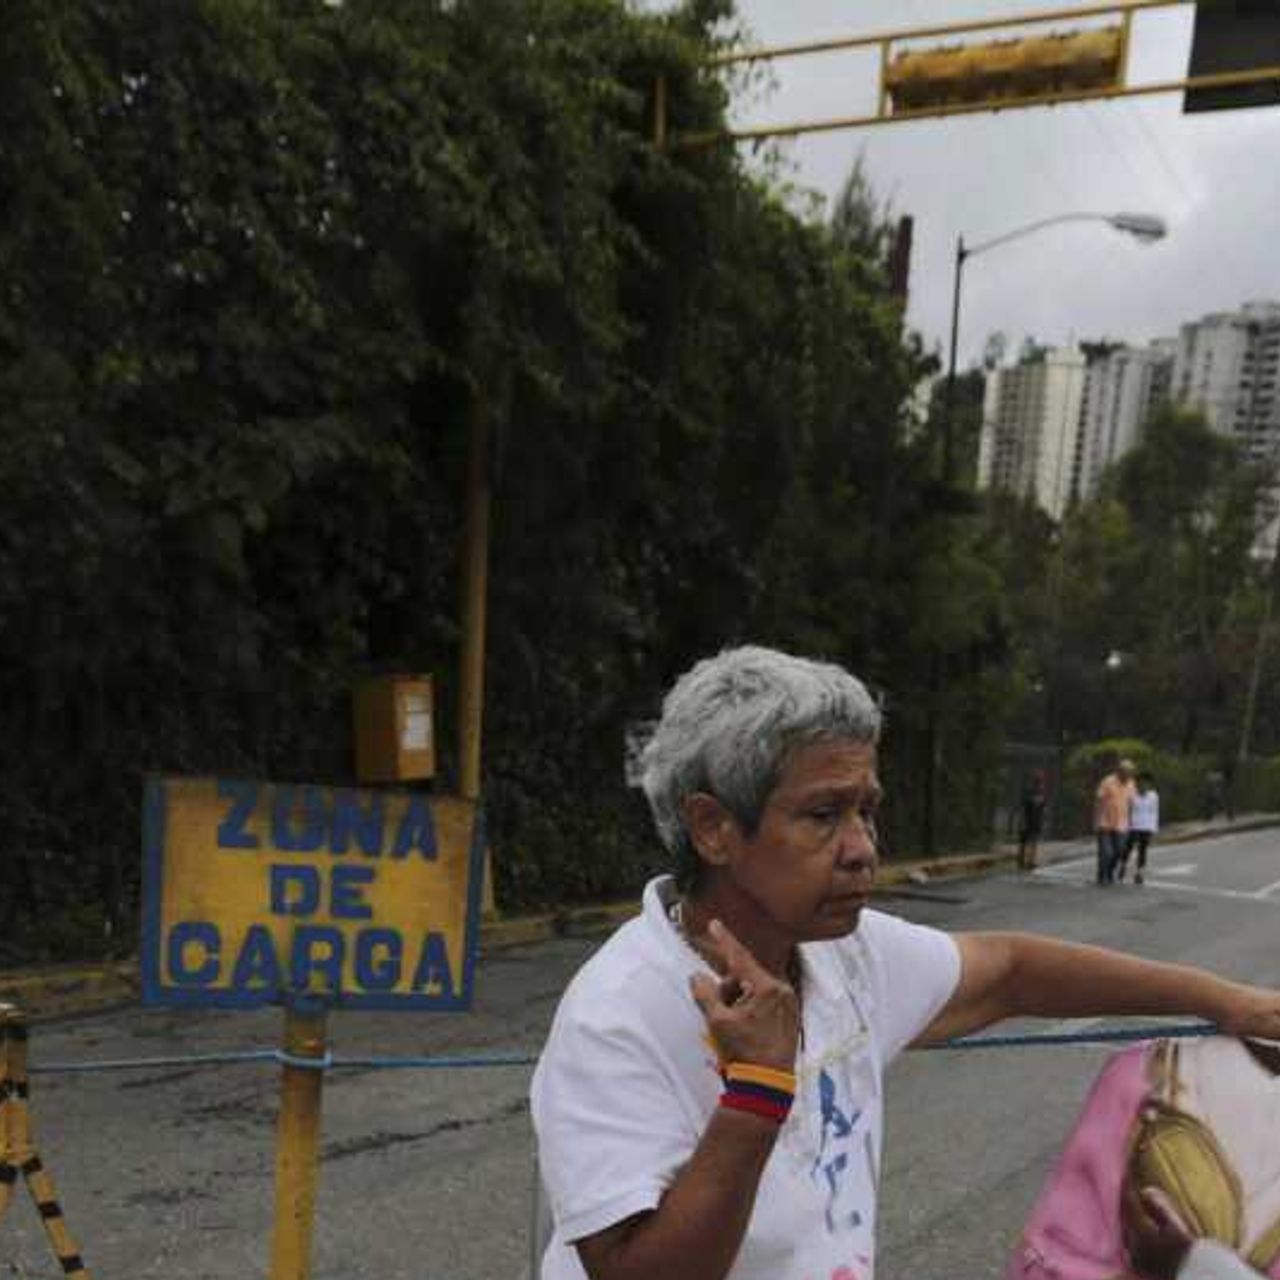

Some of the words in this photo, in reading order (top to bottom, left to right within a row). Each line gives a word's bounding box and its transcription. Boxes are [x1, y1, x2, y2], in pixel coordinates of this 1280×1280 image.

[217, 778, 438, 862] ZONA
[270, 863, 376, 920] DE
[167, 921, 455, 998] CARGA
